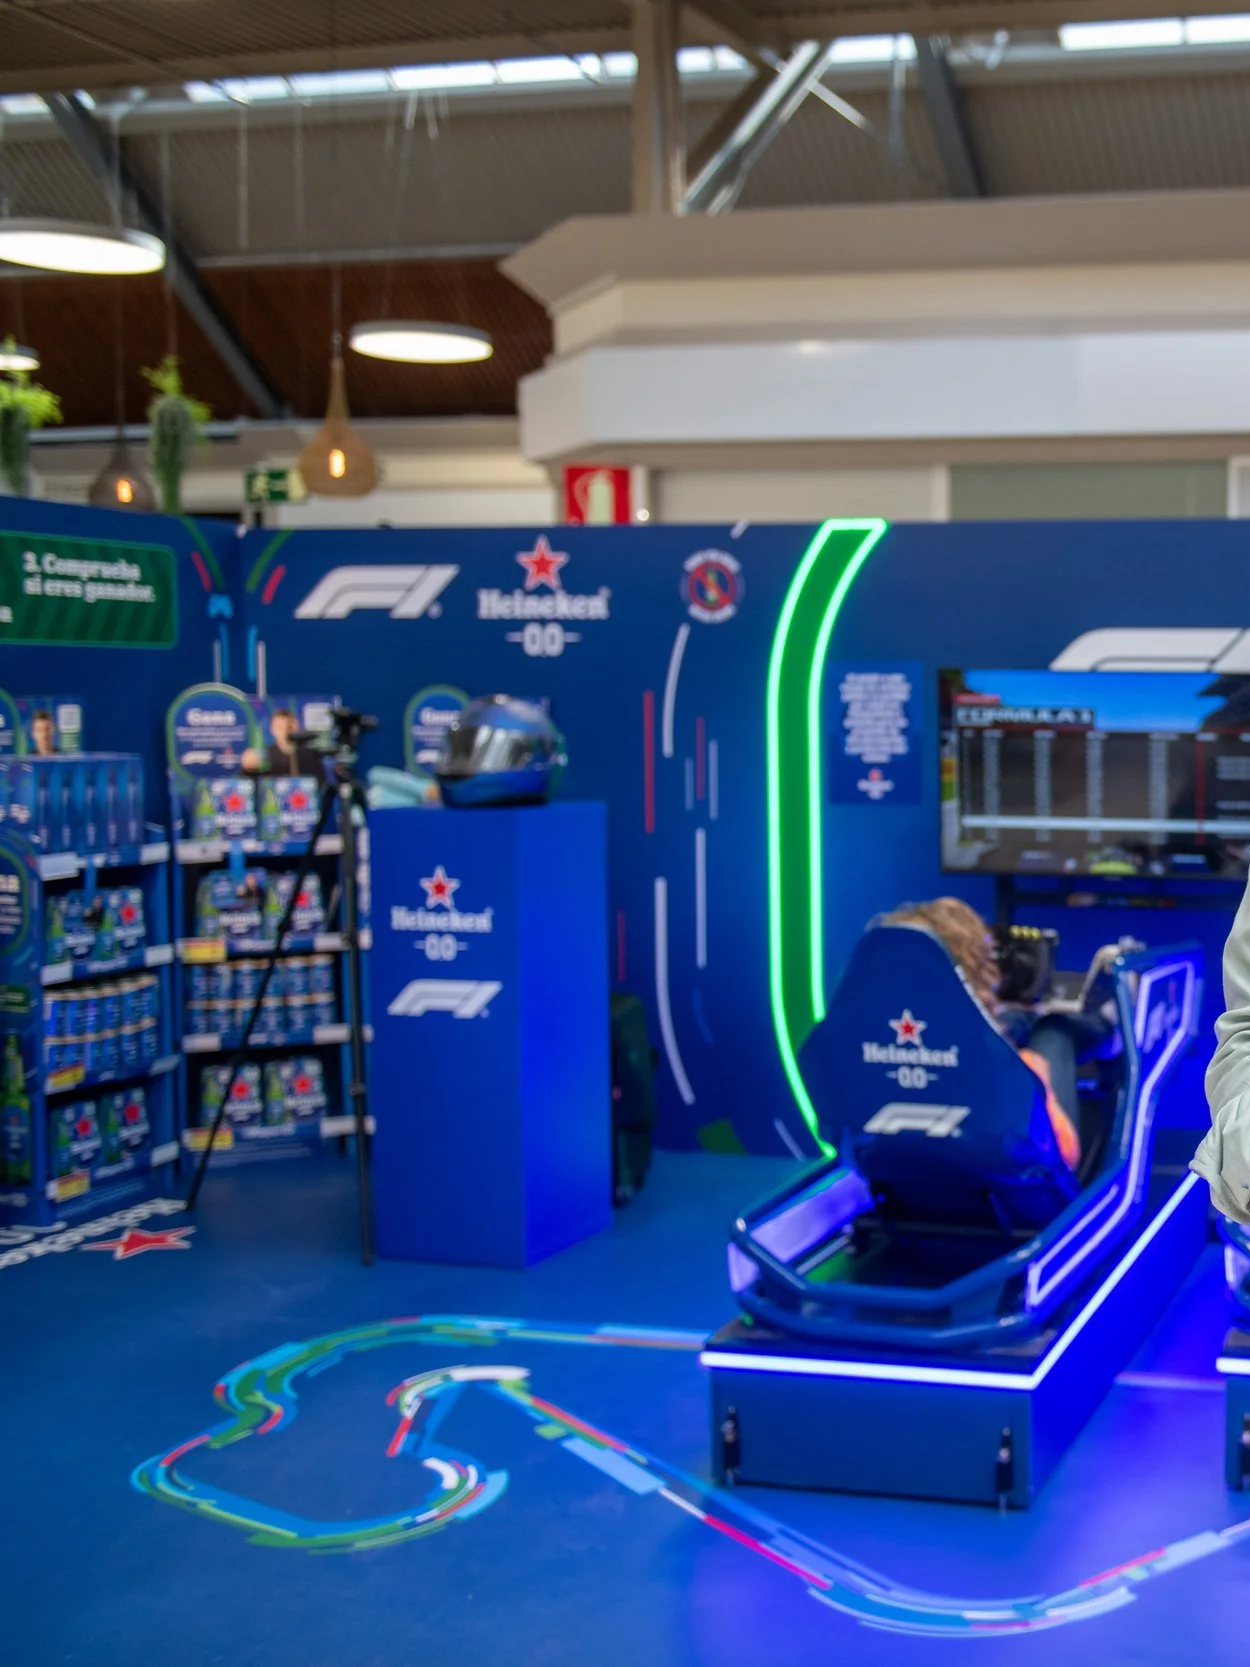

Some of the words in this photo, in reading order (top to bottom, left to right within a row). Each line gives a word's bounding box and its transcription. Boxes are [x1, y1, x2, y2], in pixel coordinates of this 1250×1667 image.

[477, 586, 611, 621] Heineken
[391, 905, 494, 933] Heineken
[862, 1041, 959, 1068] Heineken
